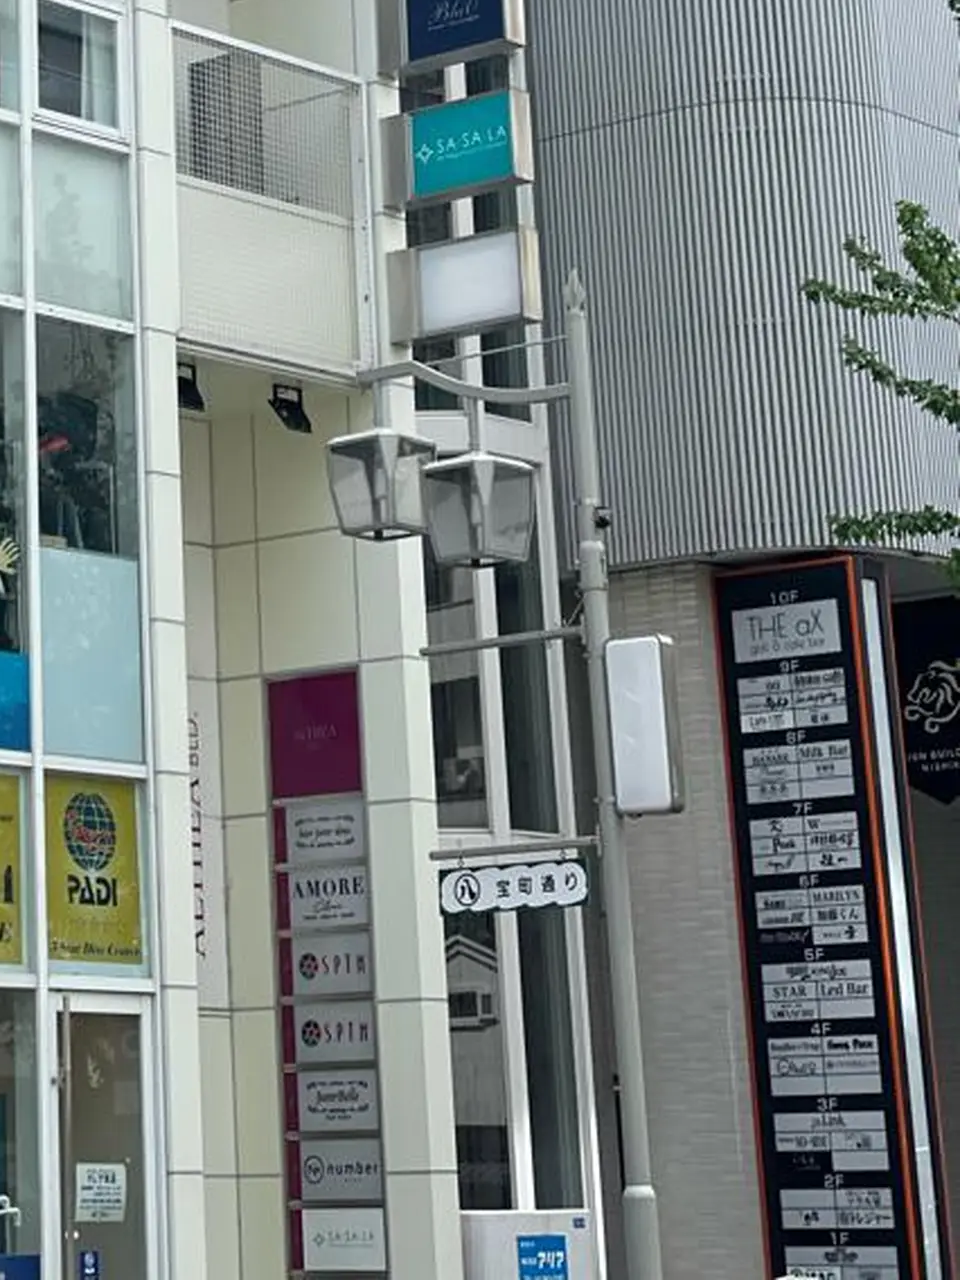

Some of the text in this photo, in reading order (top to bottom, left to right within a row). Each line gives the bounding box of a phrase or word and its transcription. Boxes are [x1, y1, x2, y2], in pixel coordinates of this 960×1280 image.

[770, 590, 800, 604] 10F
[746, 612, 789, 641] THE
[791, 801, 813, 815] 7F
[67, 876, 119, 907] PADI
[292, 875, 366, 900] AMORE
[772, 984, 808, 999] STAR
[810, 1022, 833, 1036] 4F
[817, 1097, 839, 1112] 3F
[823, 1174, 845, 1189] 2F
